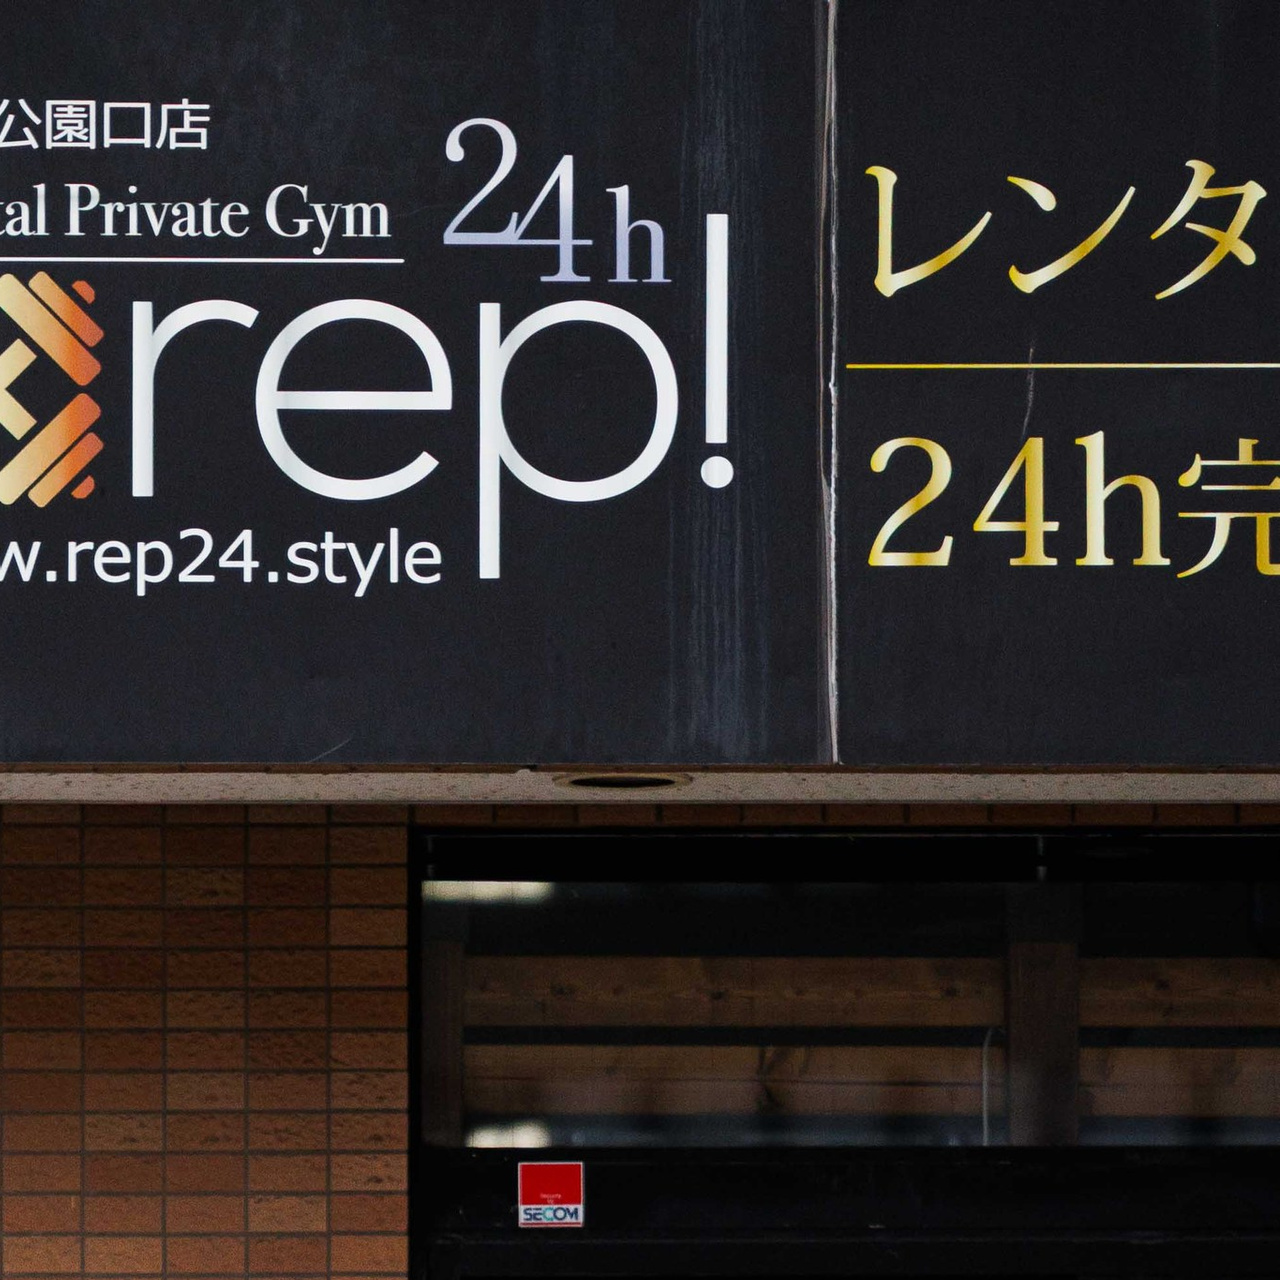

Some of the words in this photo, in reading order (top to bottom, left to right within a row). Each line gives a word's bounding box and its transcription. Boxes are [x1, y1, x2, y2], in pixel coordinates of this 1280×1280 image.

[64, 183, 250, 238] Private
[265, 183, 392, 256] Gym
[442, 117, 672, 283] 24h
[865, 159, 1268, 300] レンタ
[131, 213, 735, 580] rep!
[867, 430, 1280, 579] 24h完
[523, 1207, 579, 1221] SECOM
